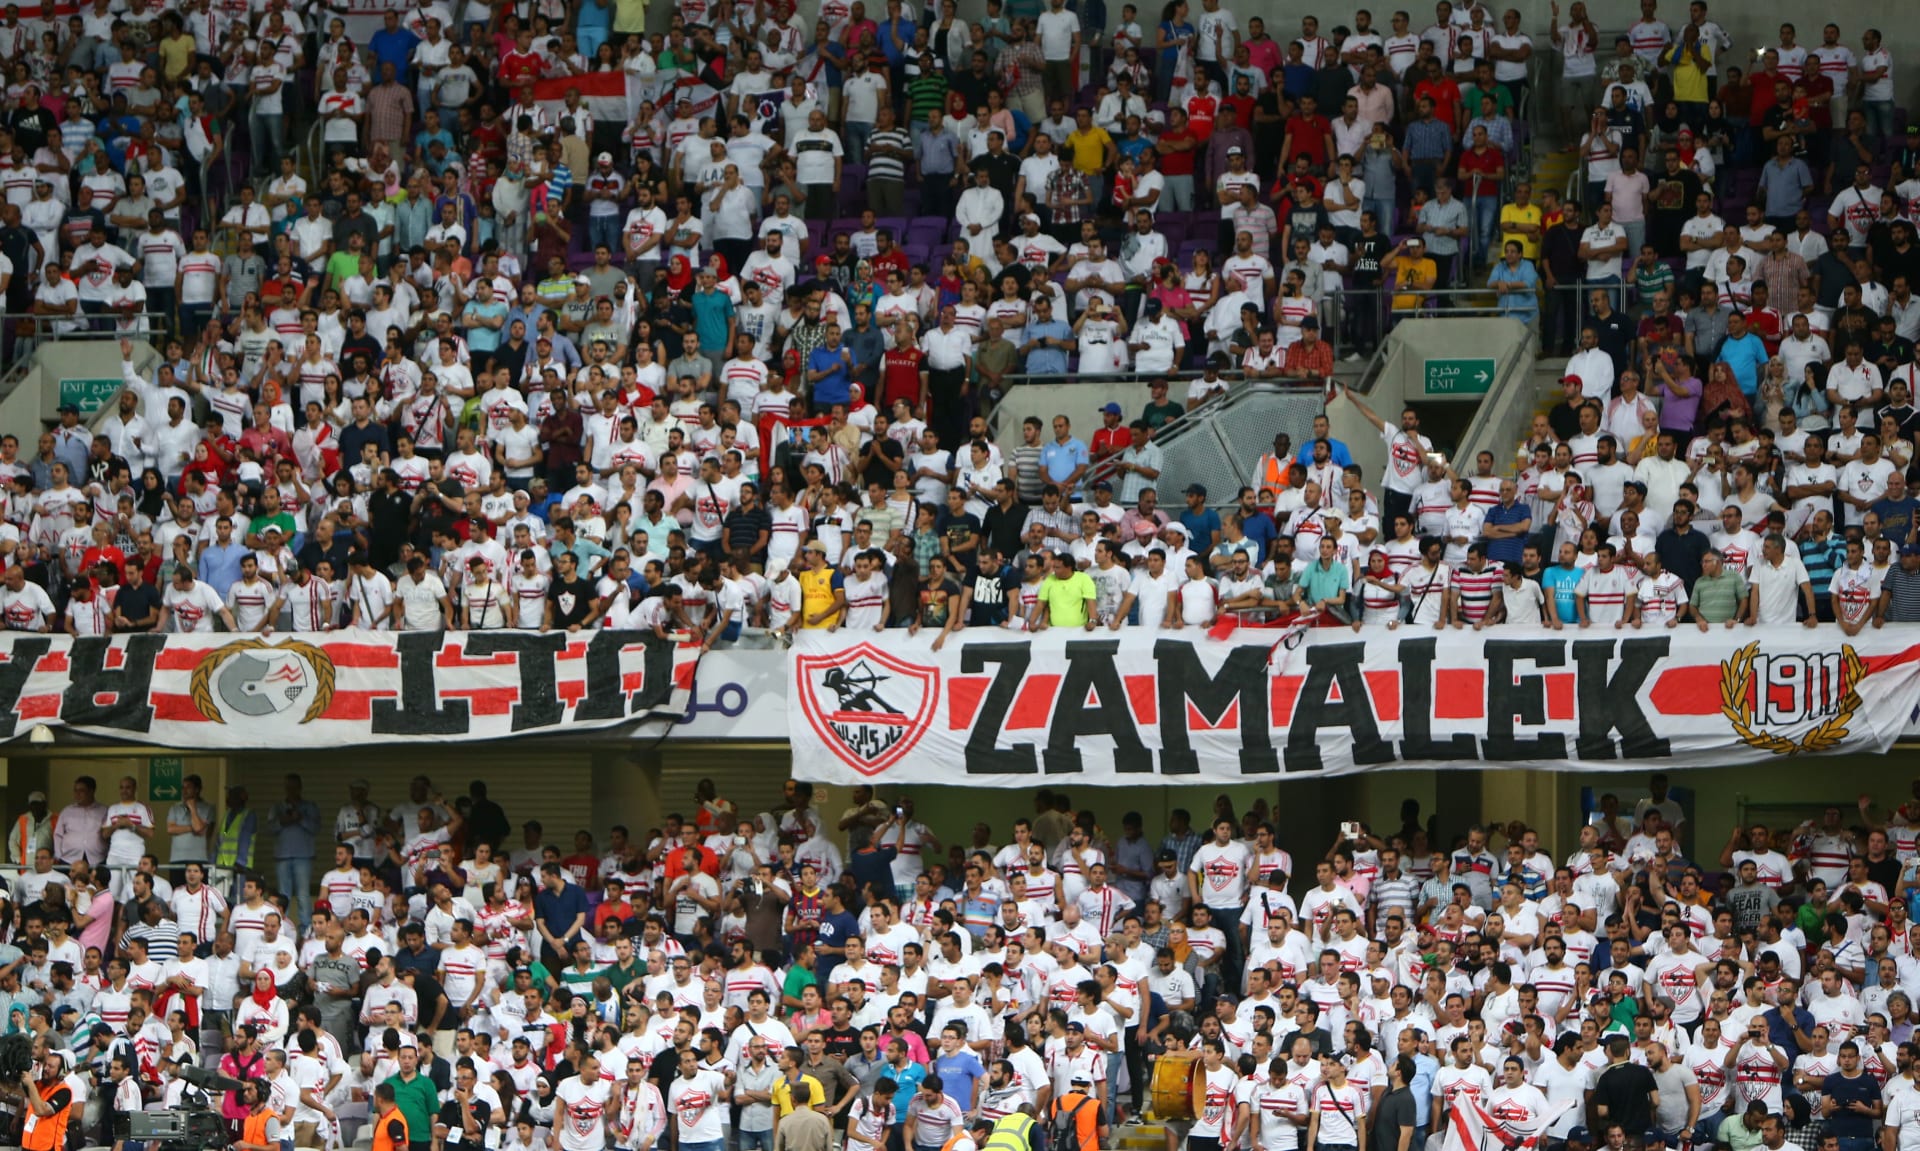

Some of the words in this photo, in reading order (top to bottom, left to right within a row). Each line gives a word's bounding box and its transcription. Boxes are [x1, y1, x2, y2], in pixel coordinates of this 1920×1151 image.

[1430, 364, 1460, 377] مخرج
[63, 382, 87, 393] EXIT
[1430, 378, 1455, 390] EXIT
[960, 637, 1672, 775] ZAMALEK
[1751, 651, 1842, 727] 1911
